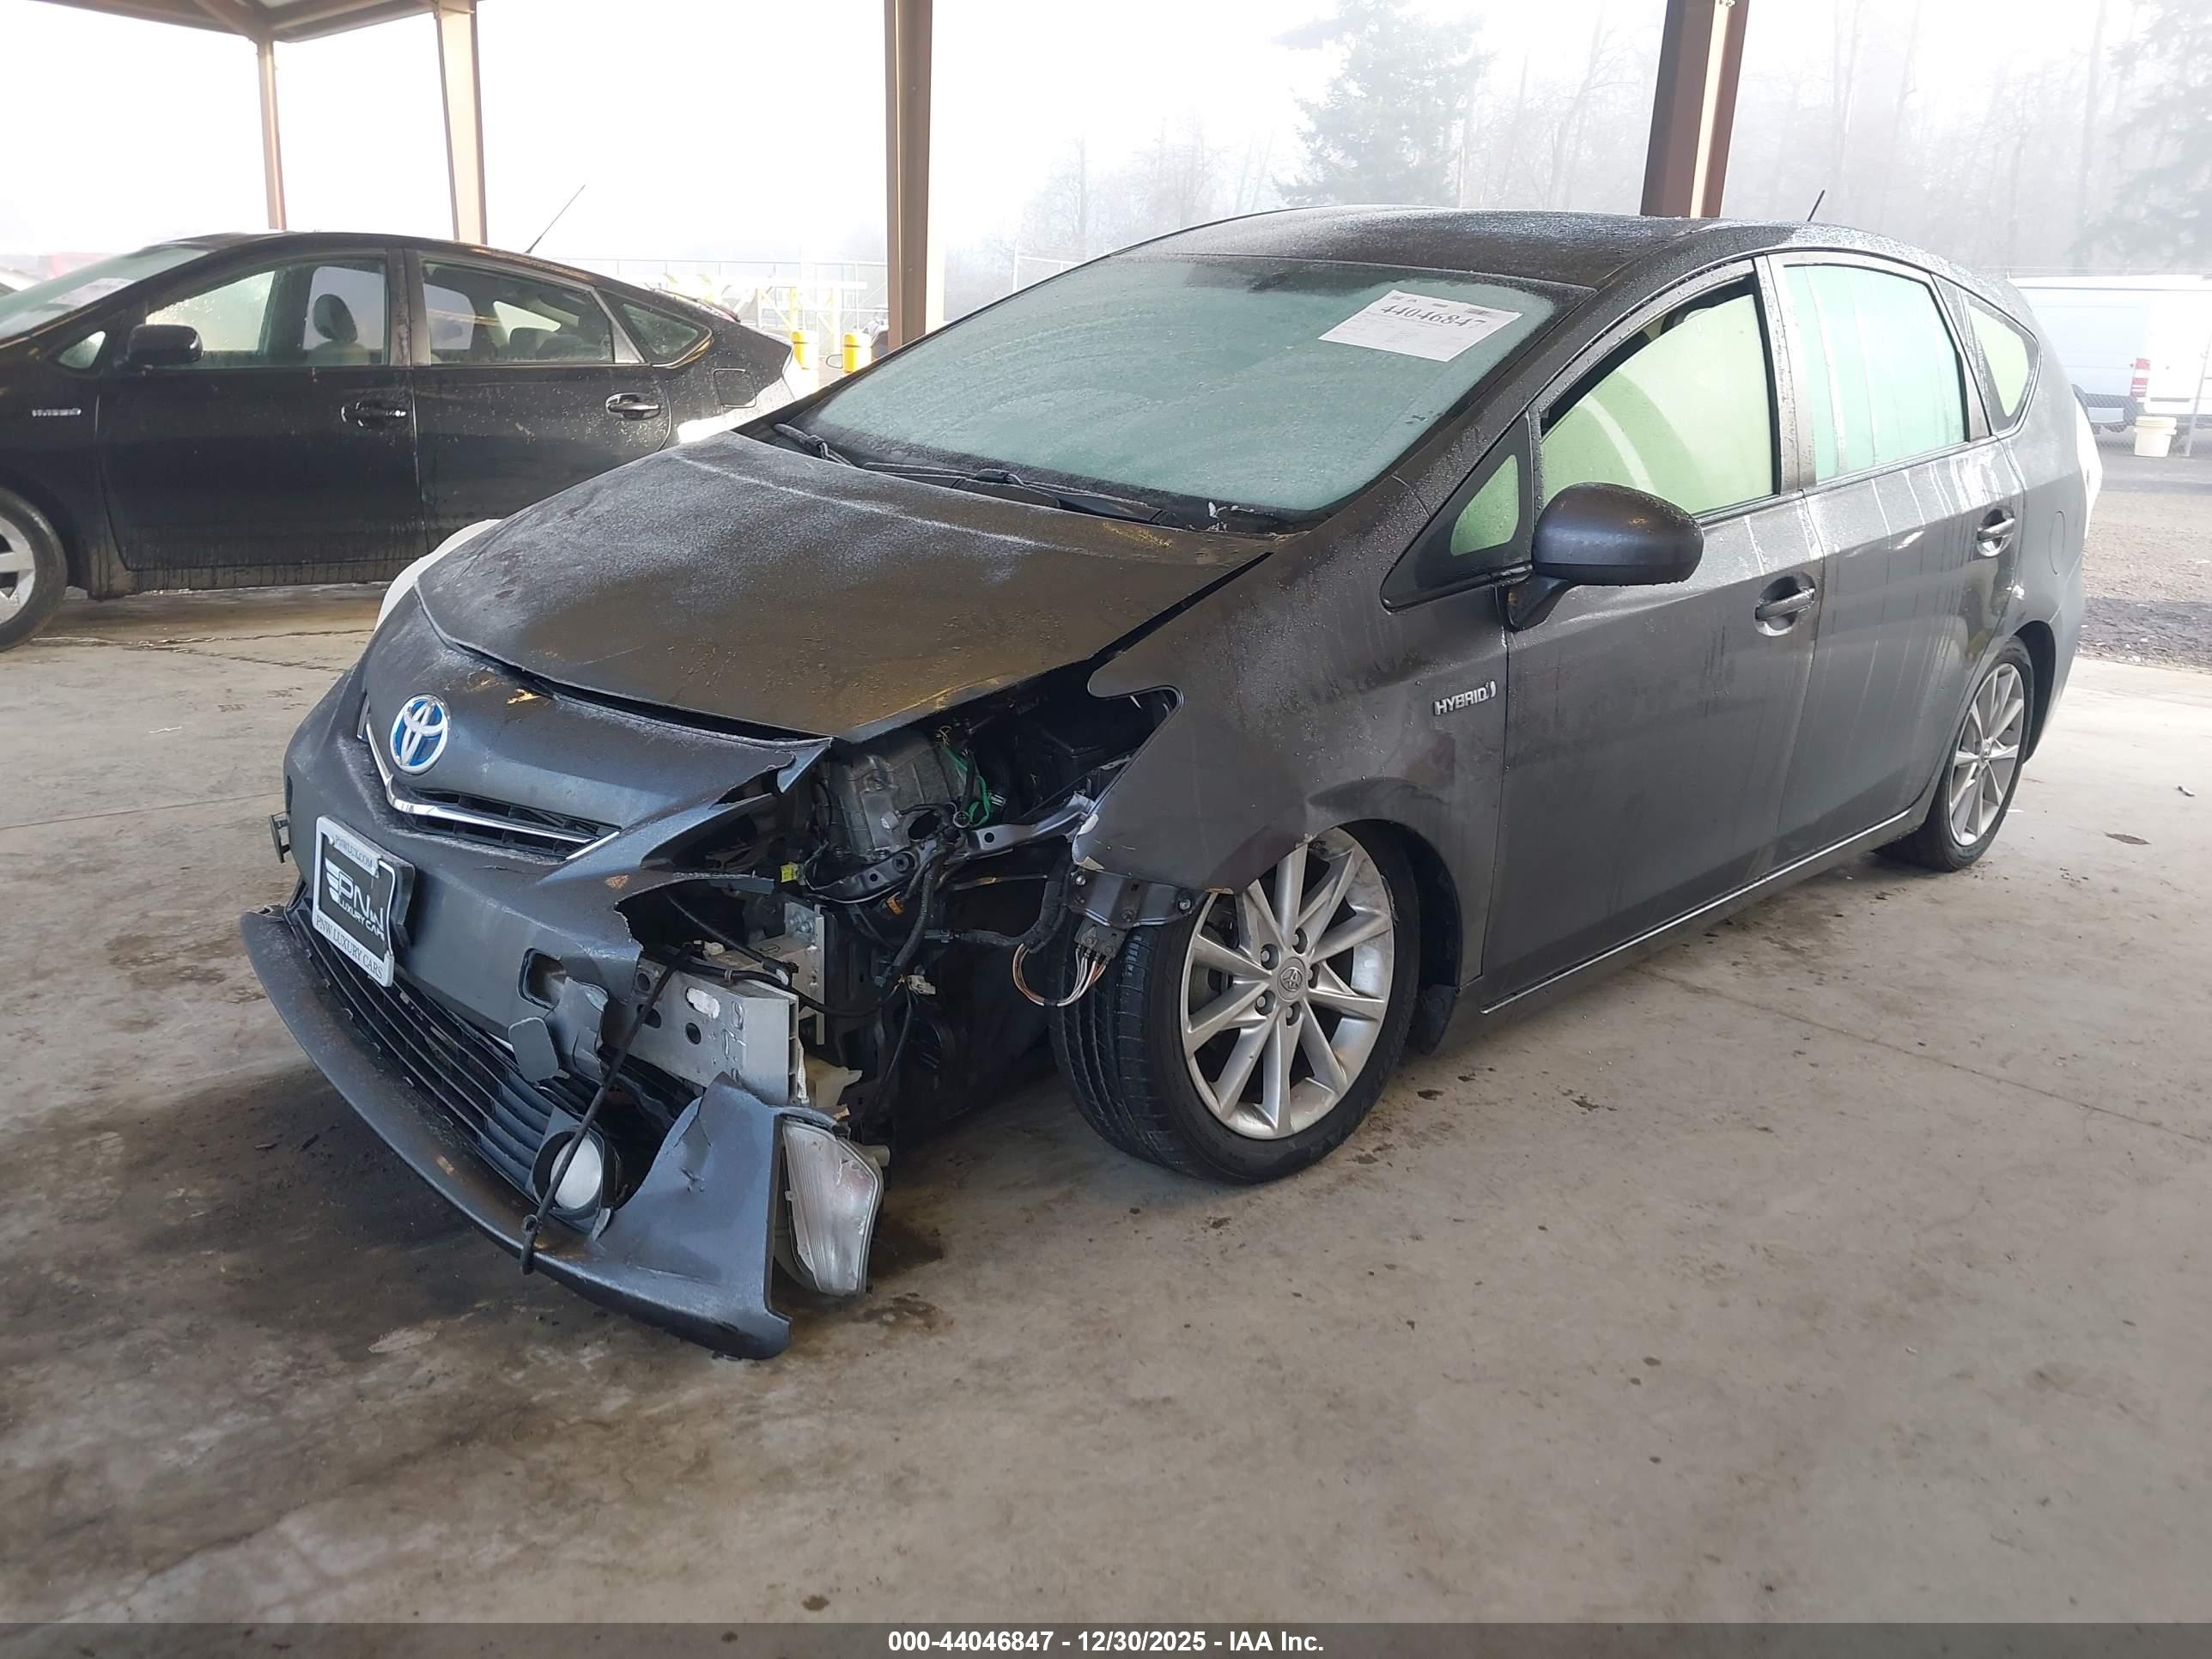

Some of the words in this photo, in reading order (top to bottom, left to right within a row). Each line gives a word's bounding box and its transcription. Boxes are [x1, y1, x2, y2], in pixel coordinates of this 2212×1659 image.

[1380, 304, 1487, 330] 44046847
[1433, 686, 1489, 716] HYBRID
[338, 872, 385, 932] PNW
[338, 898, 366, 926] LUXURY
[315, 915, 333, 937] PNW
[332, 927, 362, 963] LUXURY
[362, 954, 383, 980] CARS
